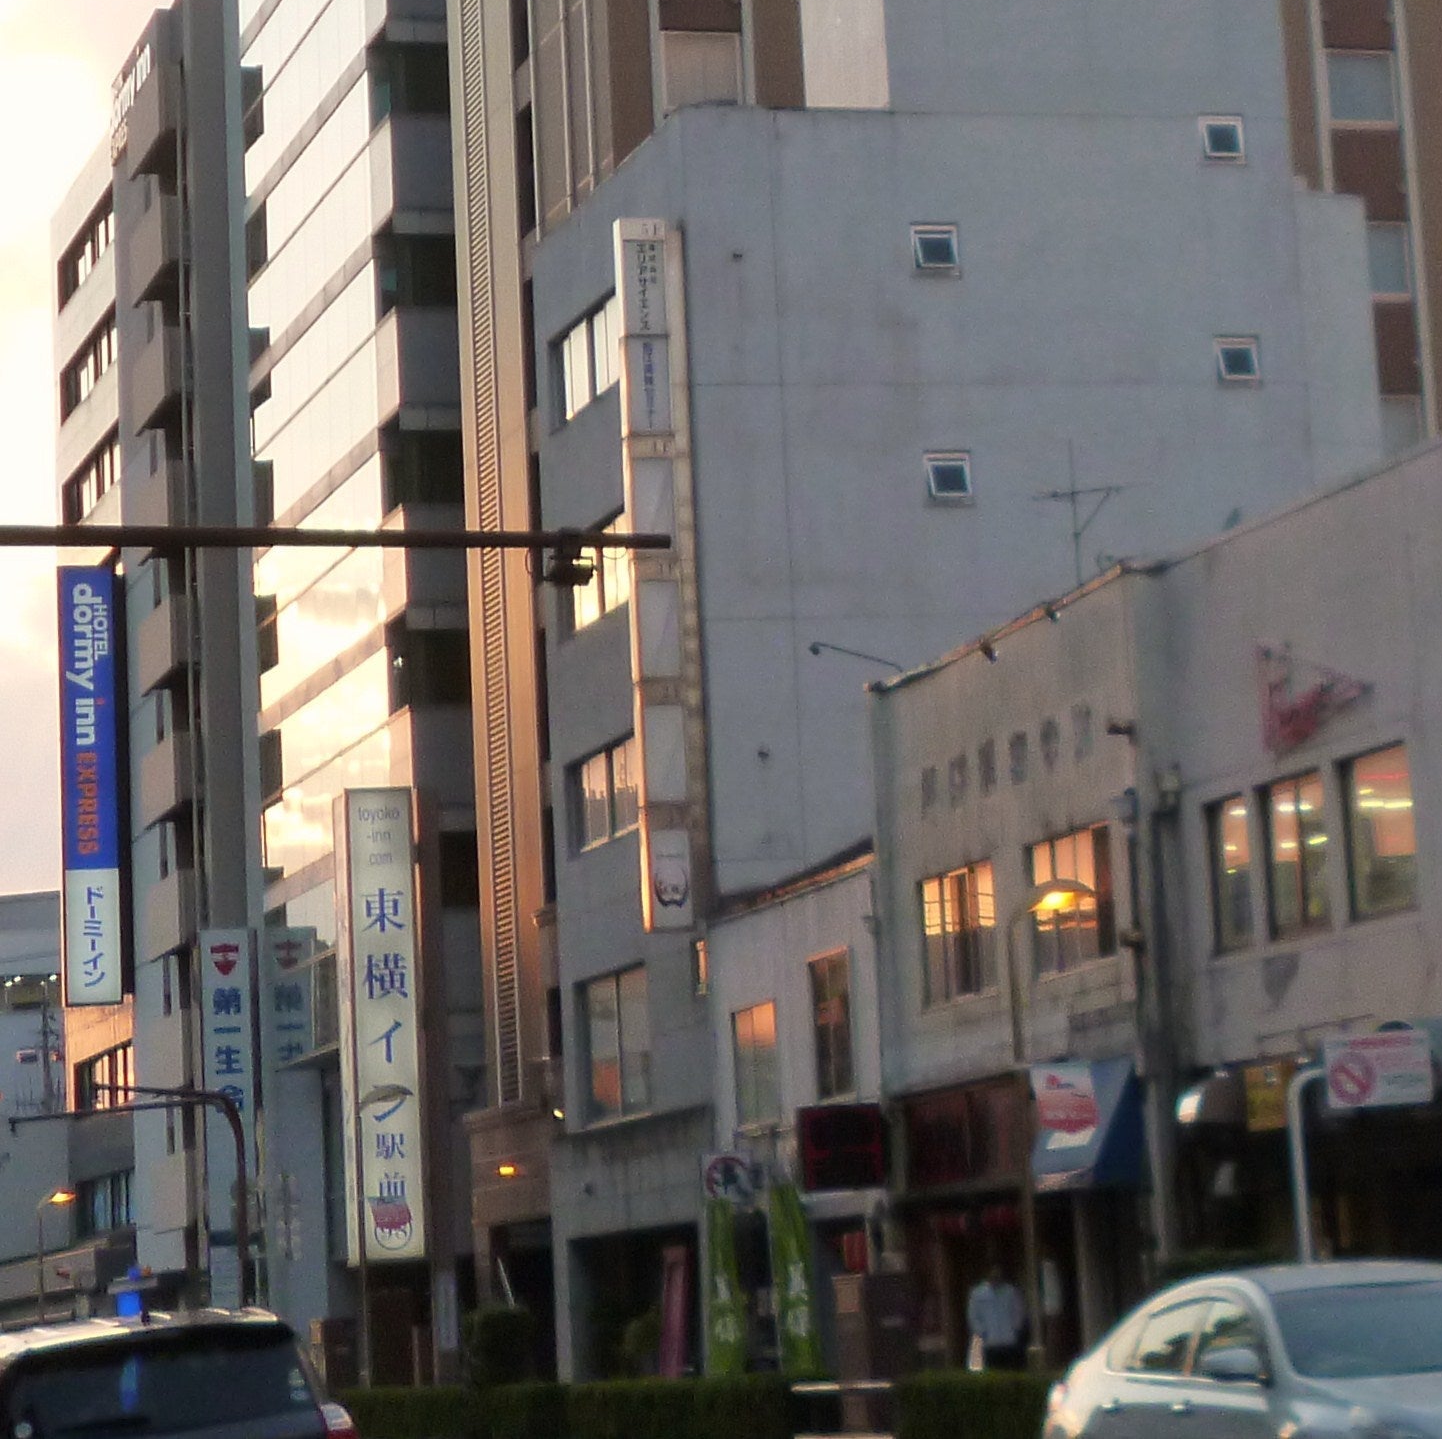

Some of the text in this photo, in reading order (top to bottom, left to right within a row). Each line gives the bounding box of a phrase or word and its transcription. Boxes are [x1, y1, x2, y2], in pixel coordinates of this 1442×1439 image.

[93, 604, 108, 660] HOTEL
[66, 582, 104, 855] dormy inn EXPRESS
[358, 806, 401, 824] toyoko
[83, 885, 106, 989] ドーミーイン
